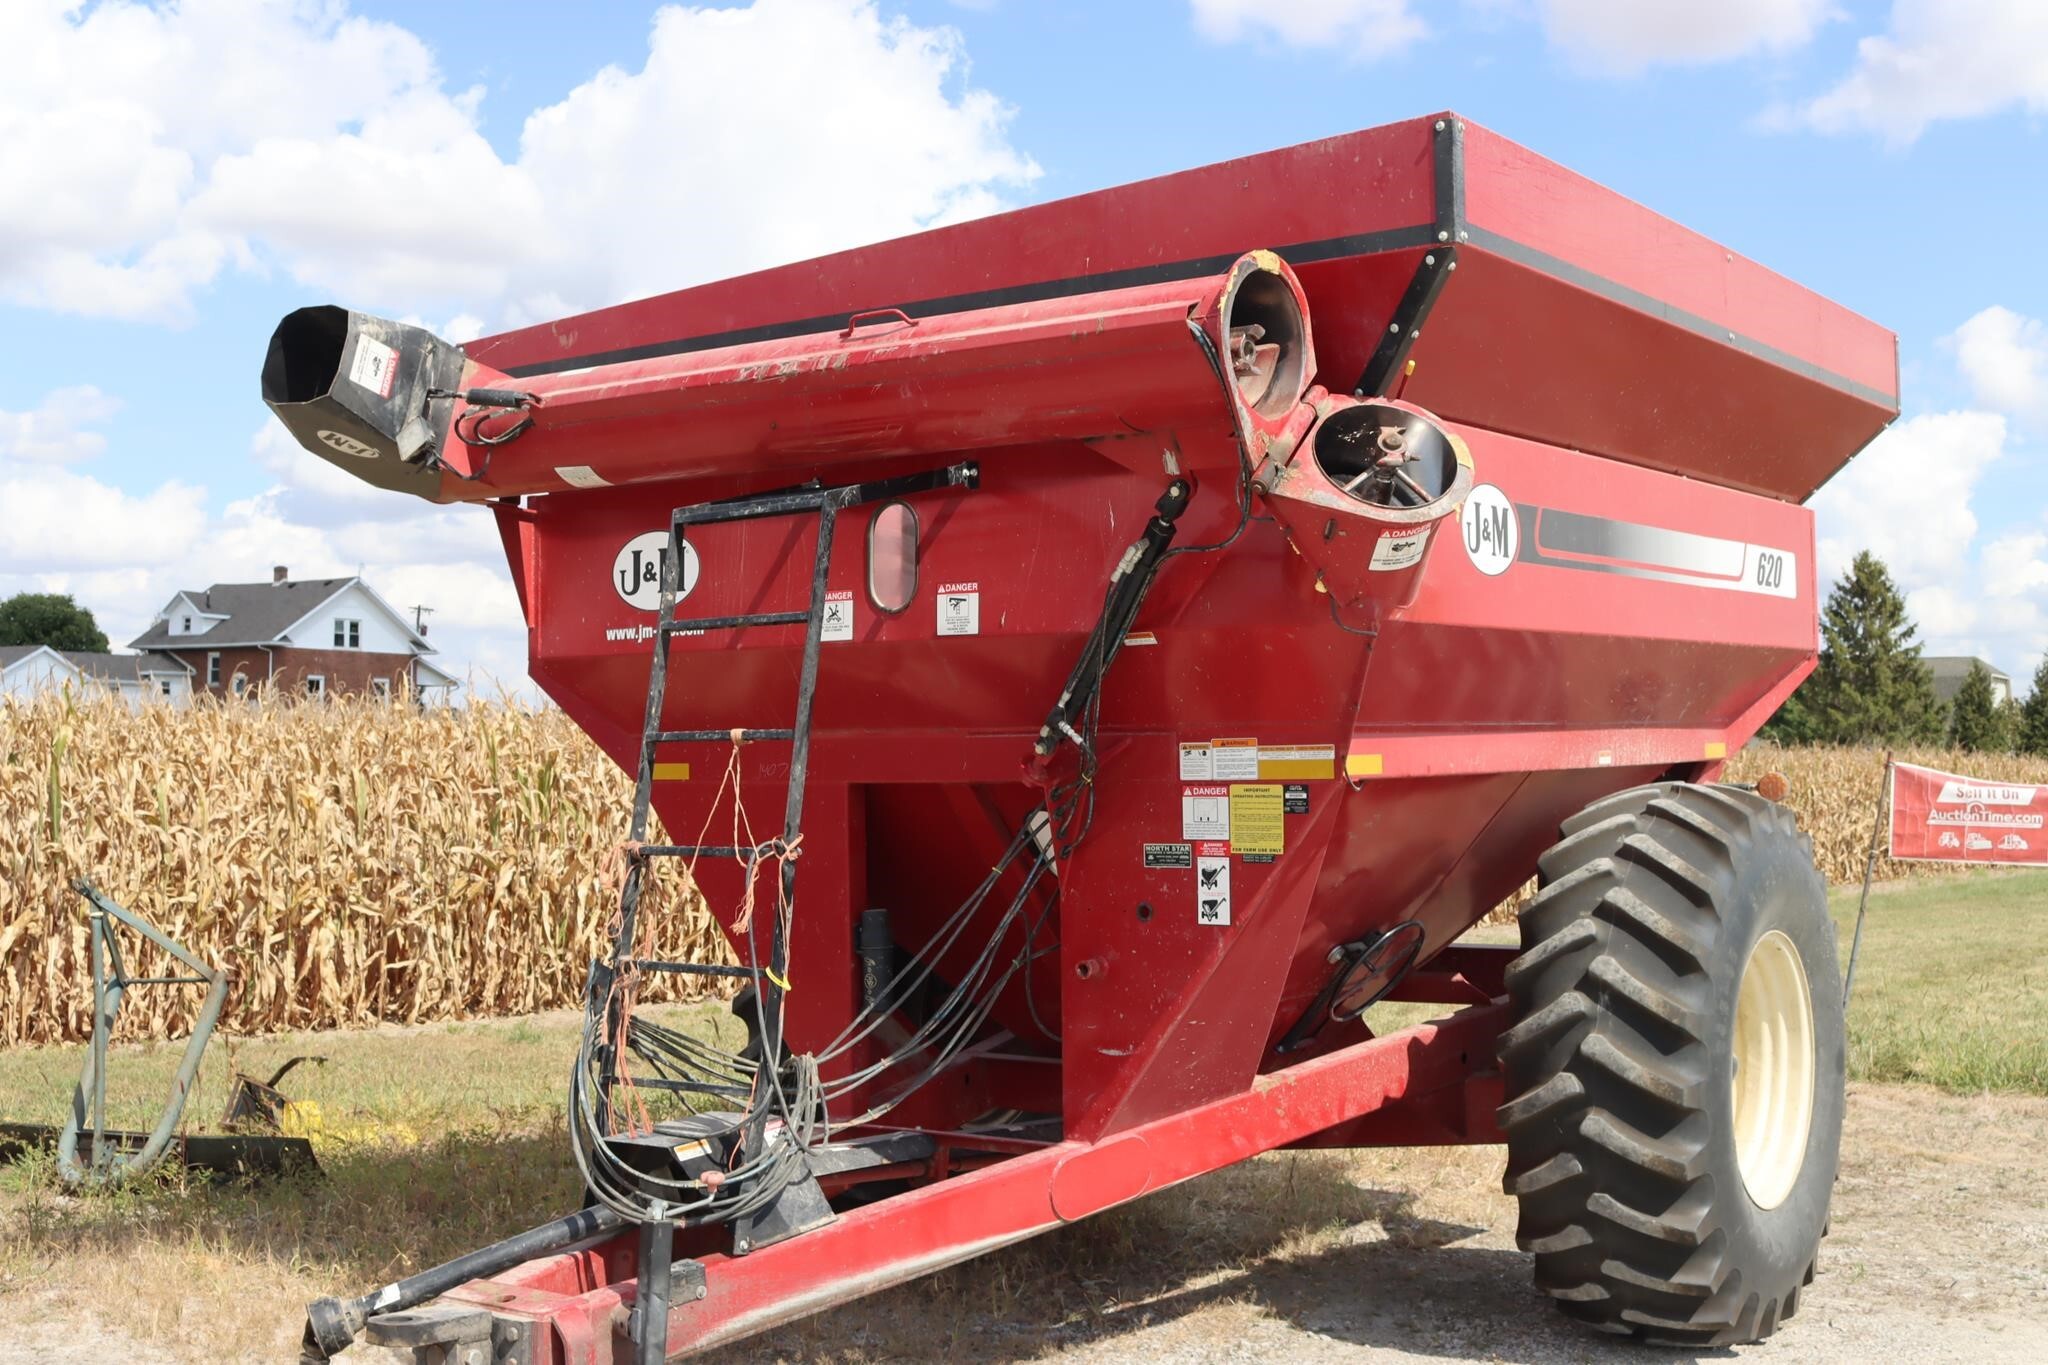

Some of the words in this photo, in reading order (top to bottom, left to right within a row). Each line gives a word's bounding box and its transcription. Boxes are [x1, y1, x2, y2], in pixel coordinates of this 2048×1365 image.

[381, 359, 397, 396] DANGER
[322, 432, 376, 458] J&M
[1392, 522, 1432, 538] DANGER
[1466, 502, 1509, 559] J&M
[1757, 552, 1783, 589] 620
[944, 583, 978, 592] DANGER
[824, 591, 853, 601] ANGER
[1193, 787, 1228, 796] DANGER
[1956, 786, 1981, 799] Sell
[1928, 808, 2043, 824] AuctionTime.com
